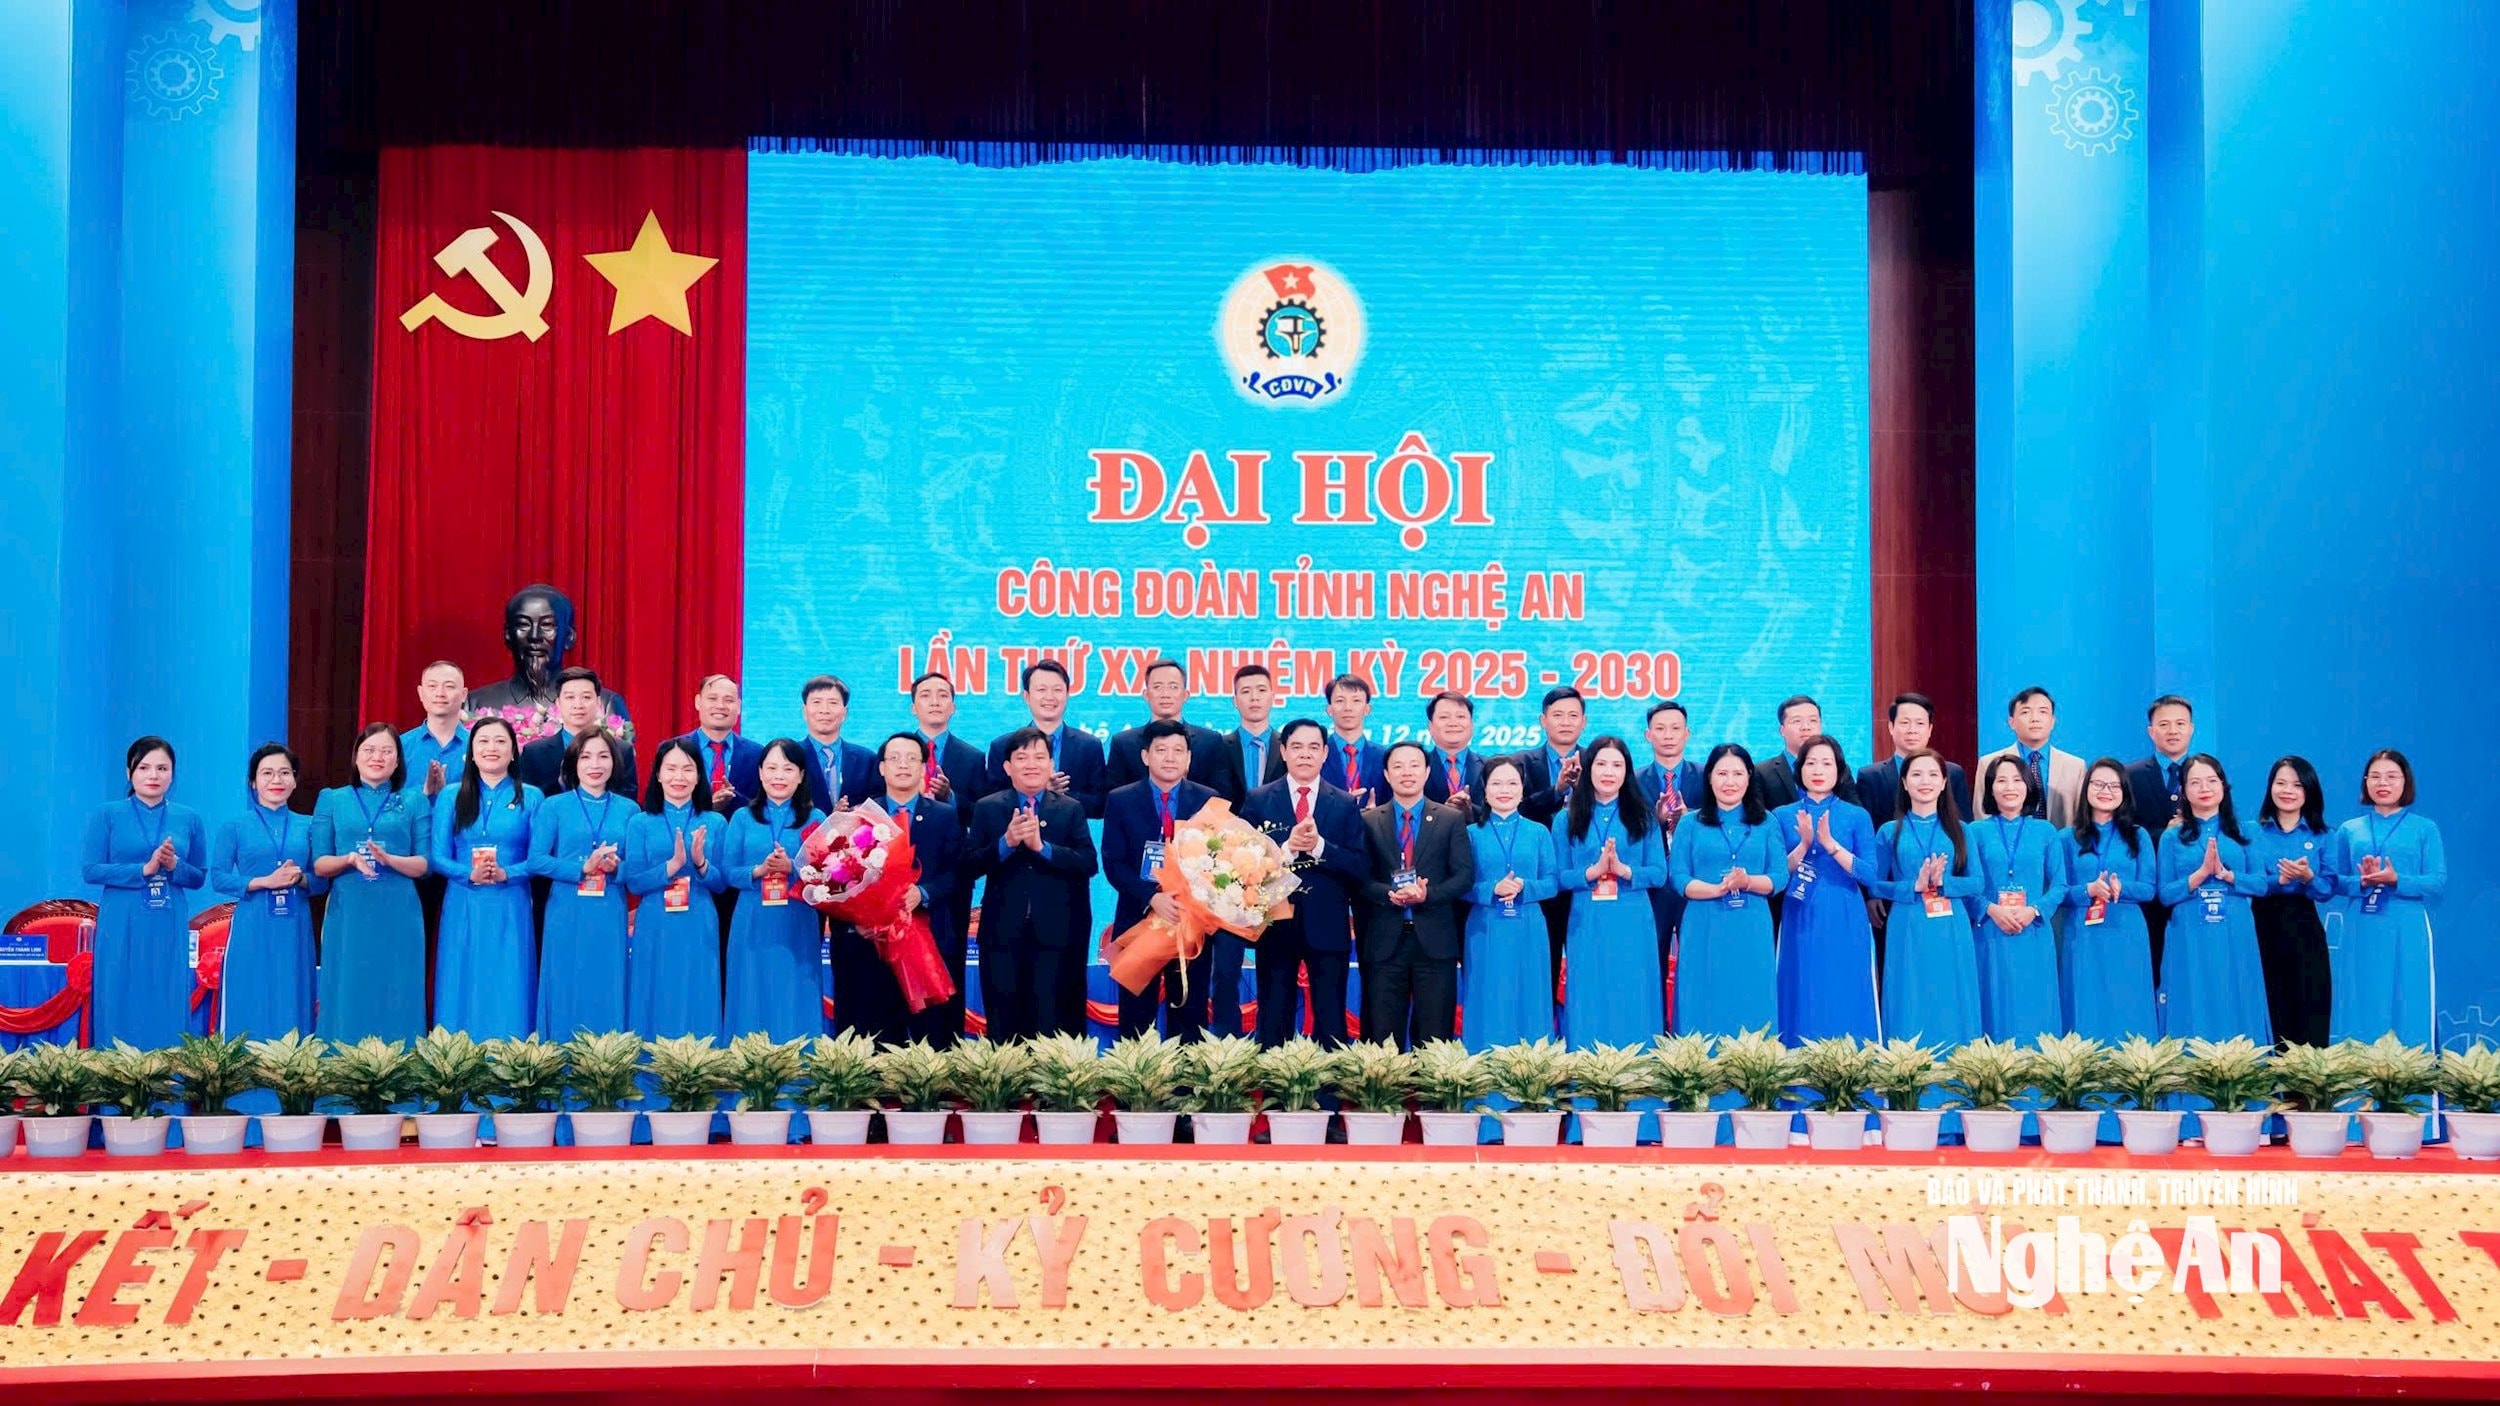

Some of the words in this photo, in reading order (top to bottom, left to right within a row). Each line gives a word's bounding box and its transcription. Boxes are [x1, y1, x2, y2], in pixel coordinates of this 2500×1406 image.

[1268, 378, 1317, 396] CĐVN
[1089, 451, 1268, 548] ĐẠI
[1296, 433, 1491, 549] HỘI
[998, 560, 1121, 616] CÔNG
[1134, 562, 1258, 617] ĐOÀN
[1272, 556, 1373, 618] TỈNH
[1389, 564, 1506, 628] NGHỆ
[1521, 573, 1583, 619] AN
[899, 631, 986, 693] LẦN
[1350, 640, 1405, 696] KỲ
[1421, 651, 1526, 697] 2025
[1574, 652, 1679, 698] 2030
[1381, 724, 1410, 746] 12
[1479, 724, 1542, 747] 2025
[0, 1199, 248, 1327] KẾT
[331, 1206, 590, 1321] DÂN
[614, 1186, 840, 1312] CHỦ
[951, 1185, 1089, 1309] KỶ
[1139, 1205, 1503, 1312] CƯƠNG
[1606, 1181, 1801, 1318] ĐỔI
